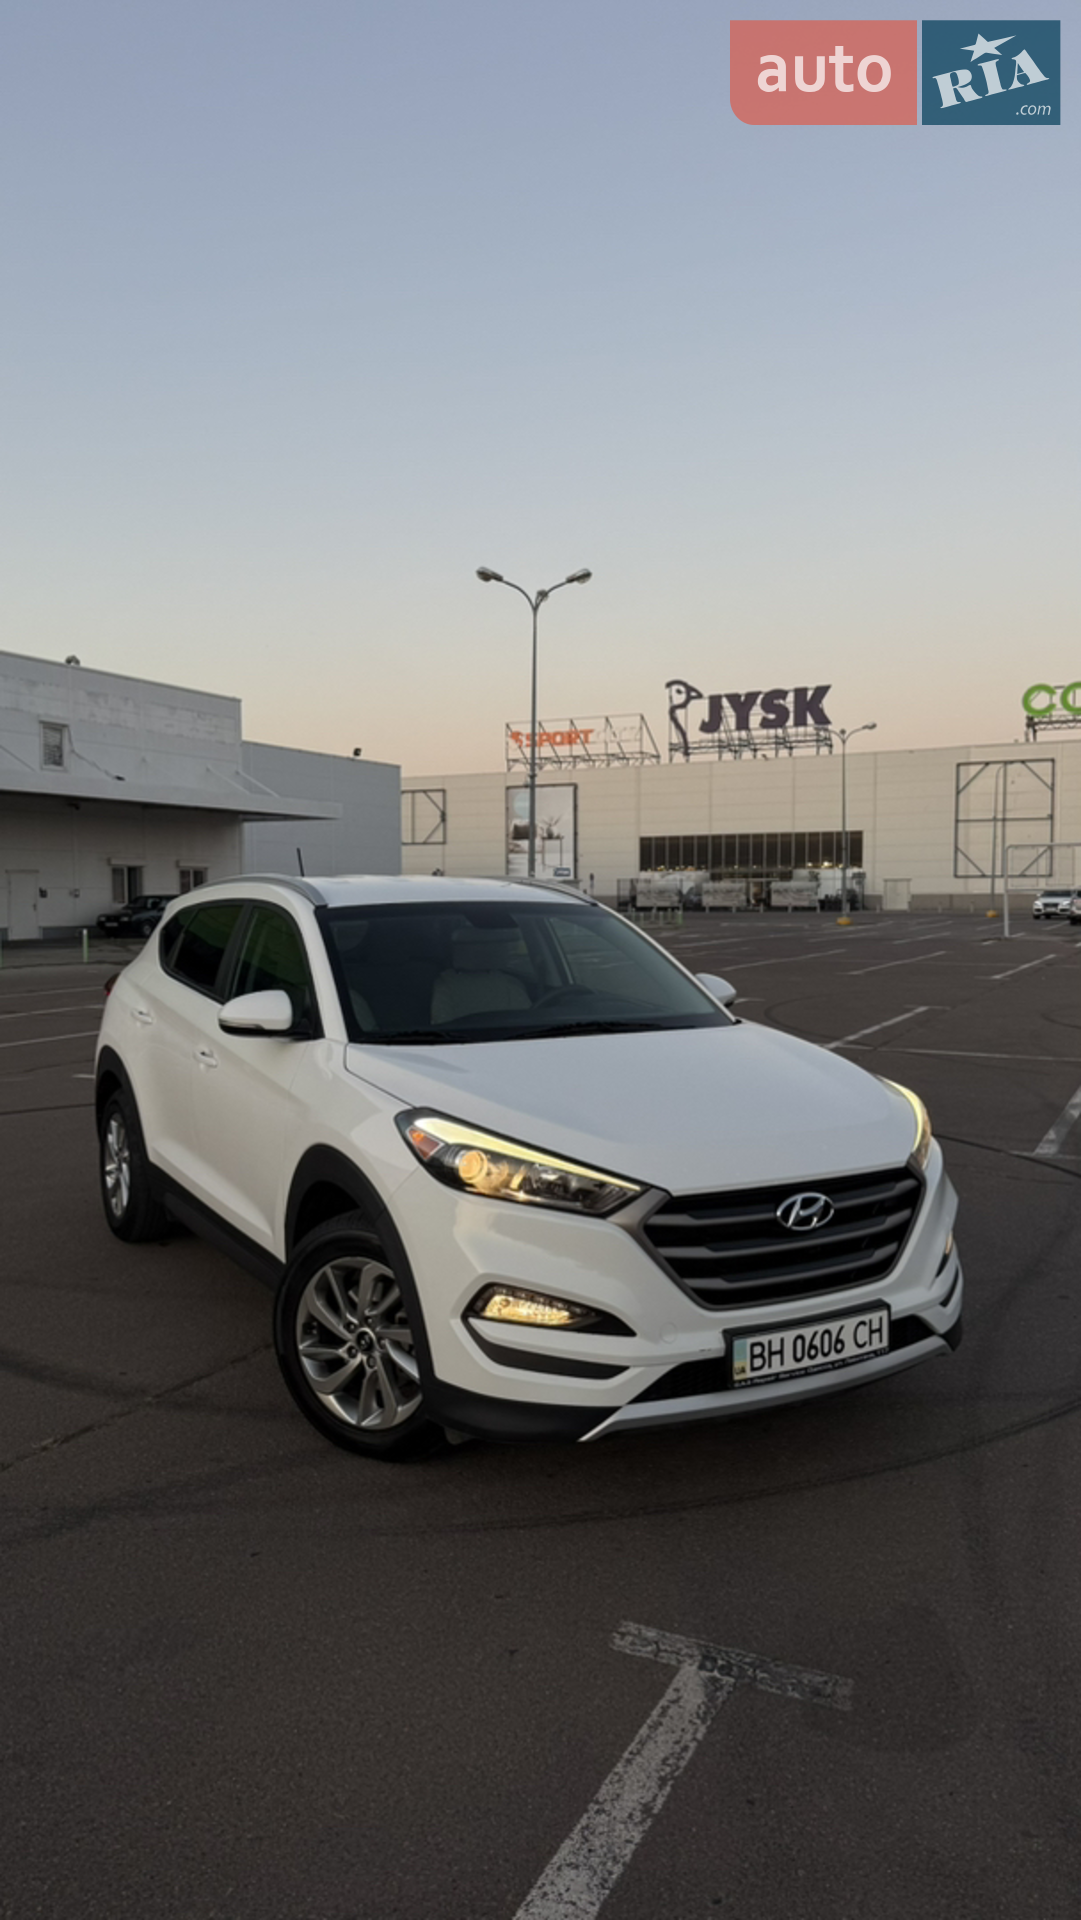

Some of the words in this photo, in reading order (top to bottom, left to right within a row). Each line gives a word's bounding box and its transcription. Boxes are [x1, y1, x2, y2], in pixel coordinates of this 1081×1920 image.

[699, 684, 832, 734] JYSK
[749, 1337, 785, 1372] BH
[792, 1325, 845, 1363] 0606
[853, 1316, 883, 1349] CH
